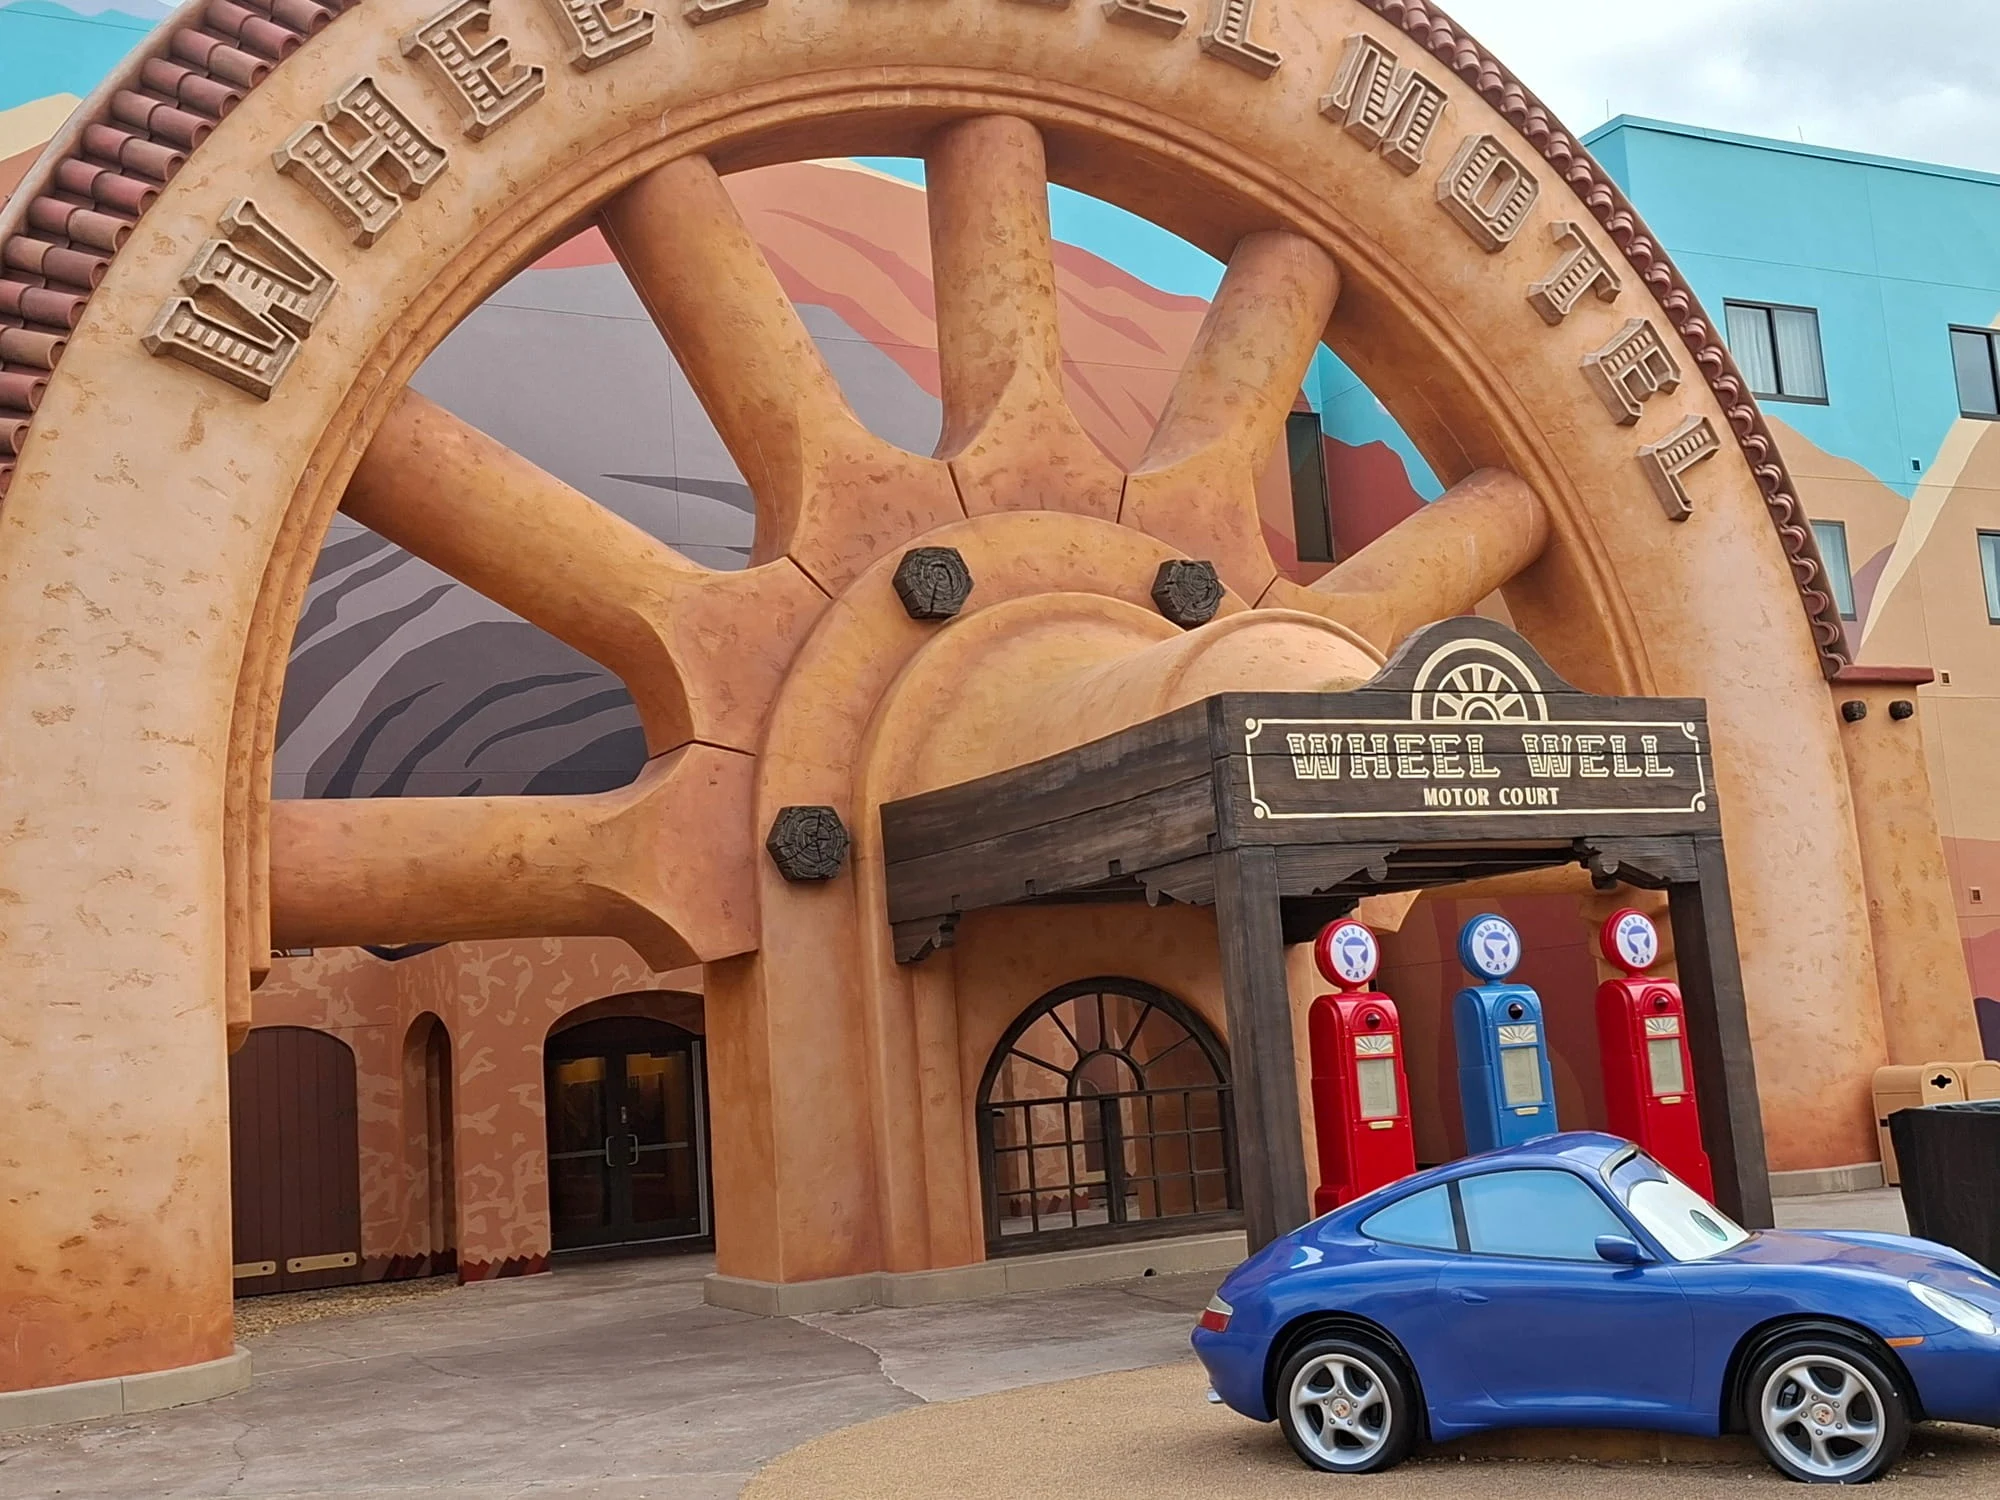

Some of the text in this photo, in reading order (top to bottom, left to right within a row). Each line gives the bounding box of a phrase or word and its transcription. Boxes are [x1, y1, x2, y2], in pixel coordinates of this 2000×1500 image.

[141, 0, 1721, 522] WHEE MOTEL
[1286, 733, 1675, 780] WHEEL WELL
[1423, 787, 1560, 806] MOTOR COURT
